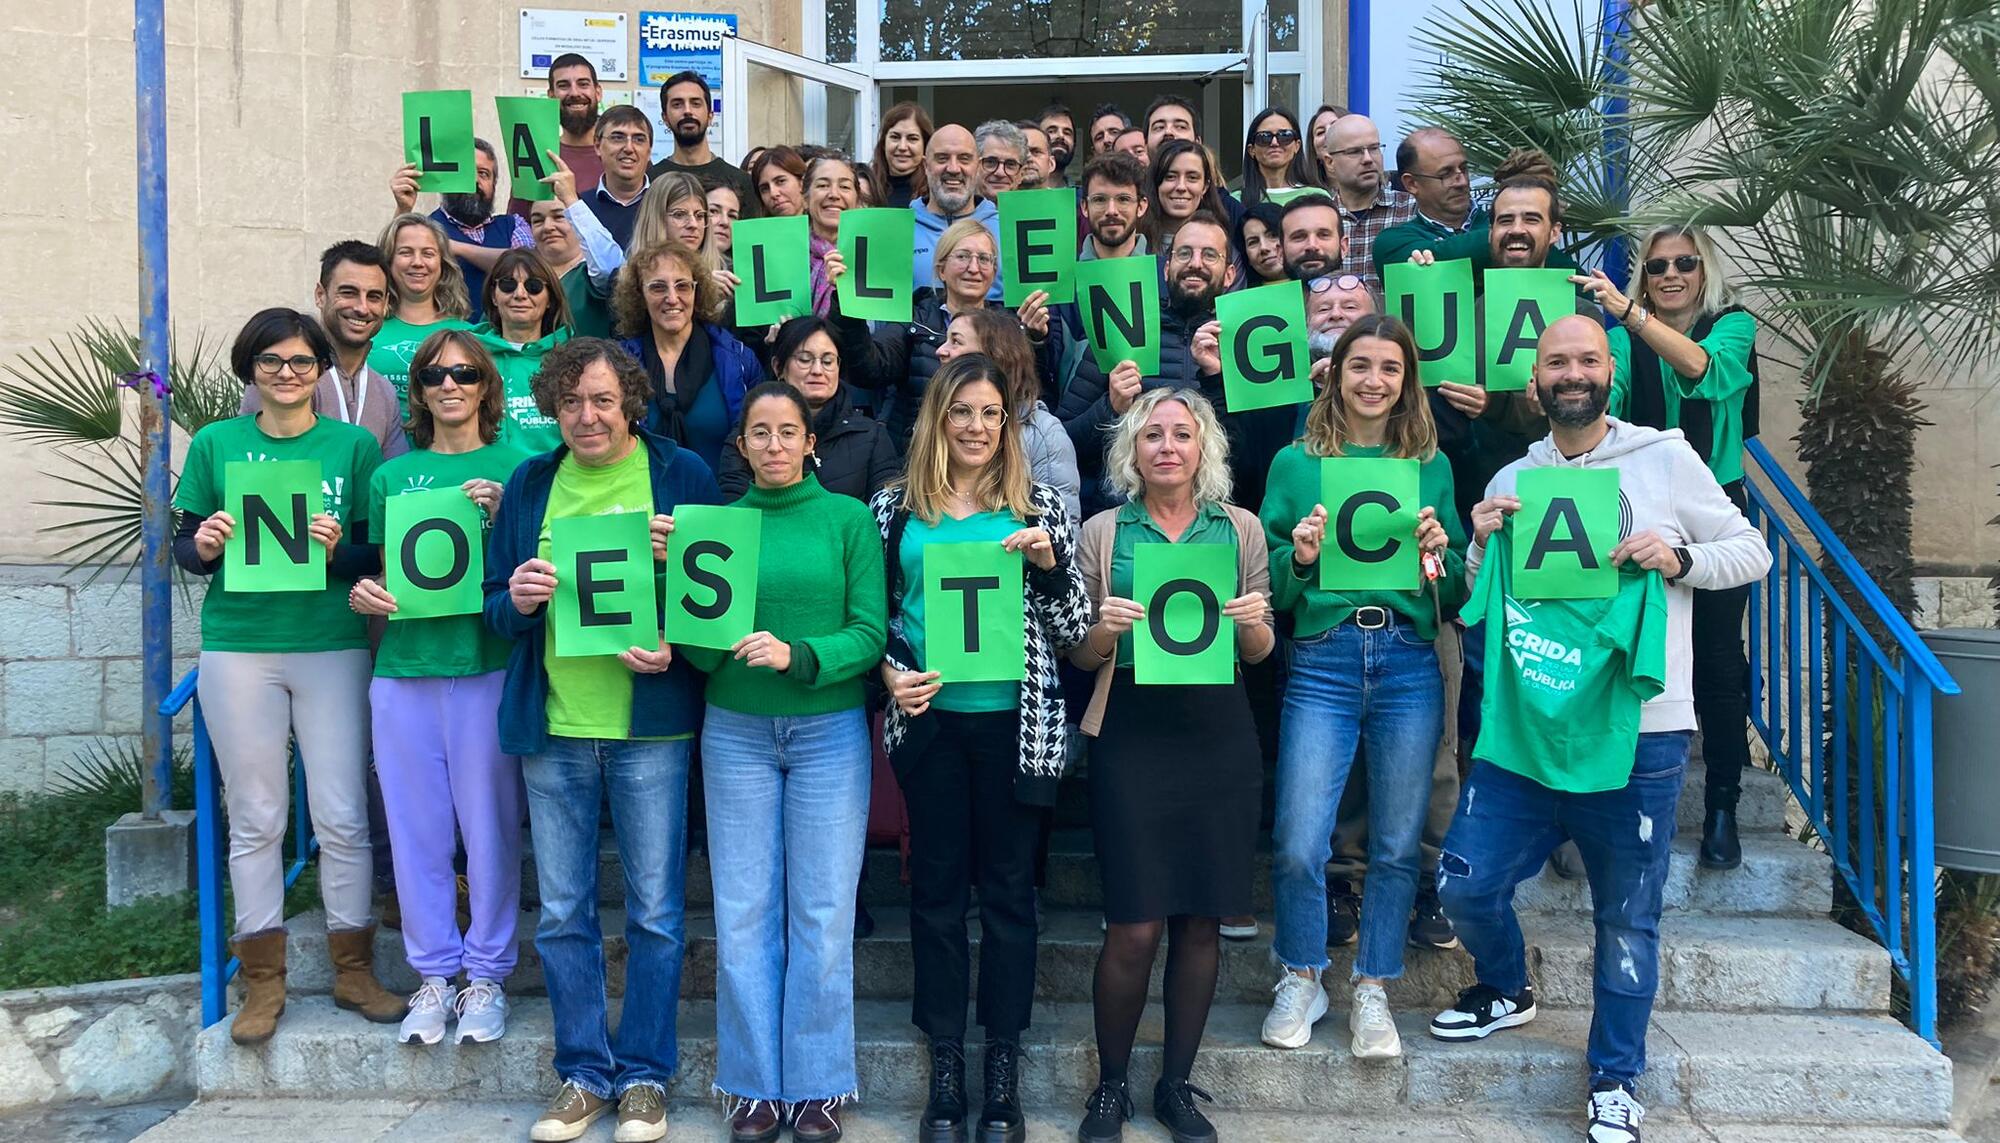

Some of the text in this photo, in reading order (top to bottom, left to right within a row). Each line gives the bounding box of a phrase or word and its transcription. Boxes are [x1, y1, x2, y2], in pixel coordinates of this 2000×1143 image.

[420, 117, 458, 172] L
[513, 123, 545, 180] A
[752, 244, 792, 303] L
[855, 236, 893, 299] L
[1016, 219, 1058, 284] E
[1088, 281, 1146, 350] N
[1233, 315, 1296, 384] G
[1401, 292, 1458, 362] U
[1496, 299, 1548, 365] A
[242, 493, 310, 565] N
[400, 517, 470, 591] O
[1336, 491, 1402, 563] C
[1525, 497, 1600, 570] A
[576, 549, 632, 627] E
[680, 540, 735, 620] S
[941, 576, 1000, 653] T
[1148, 578, 1220, 656] O
[1508, 628, 1582, 666] CRIDA
